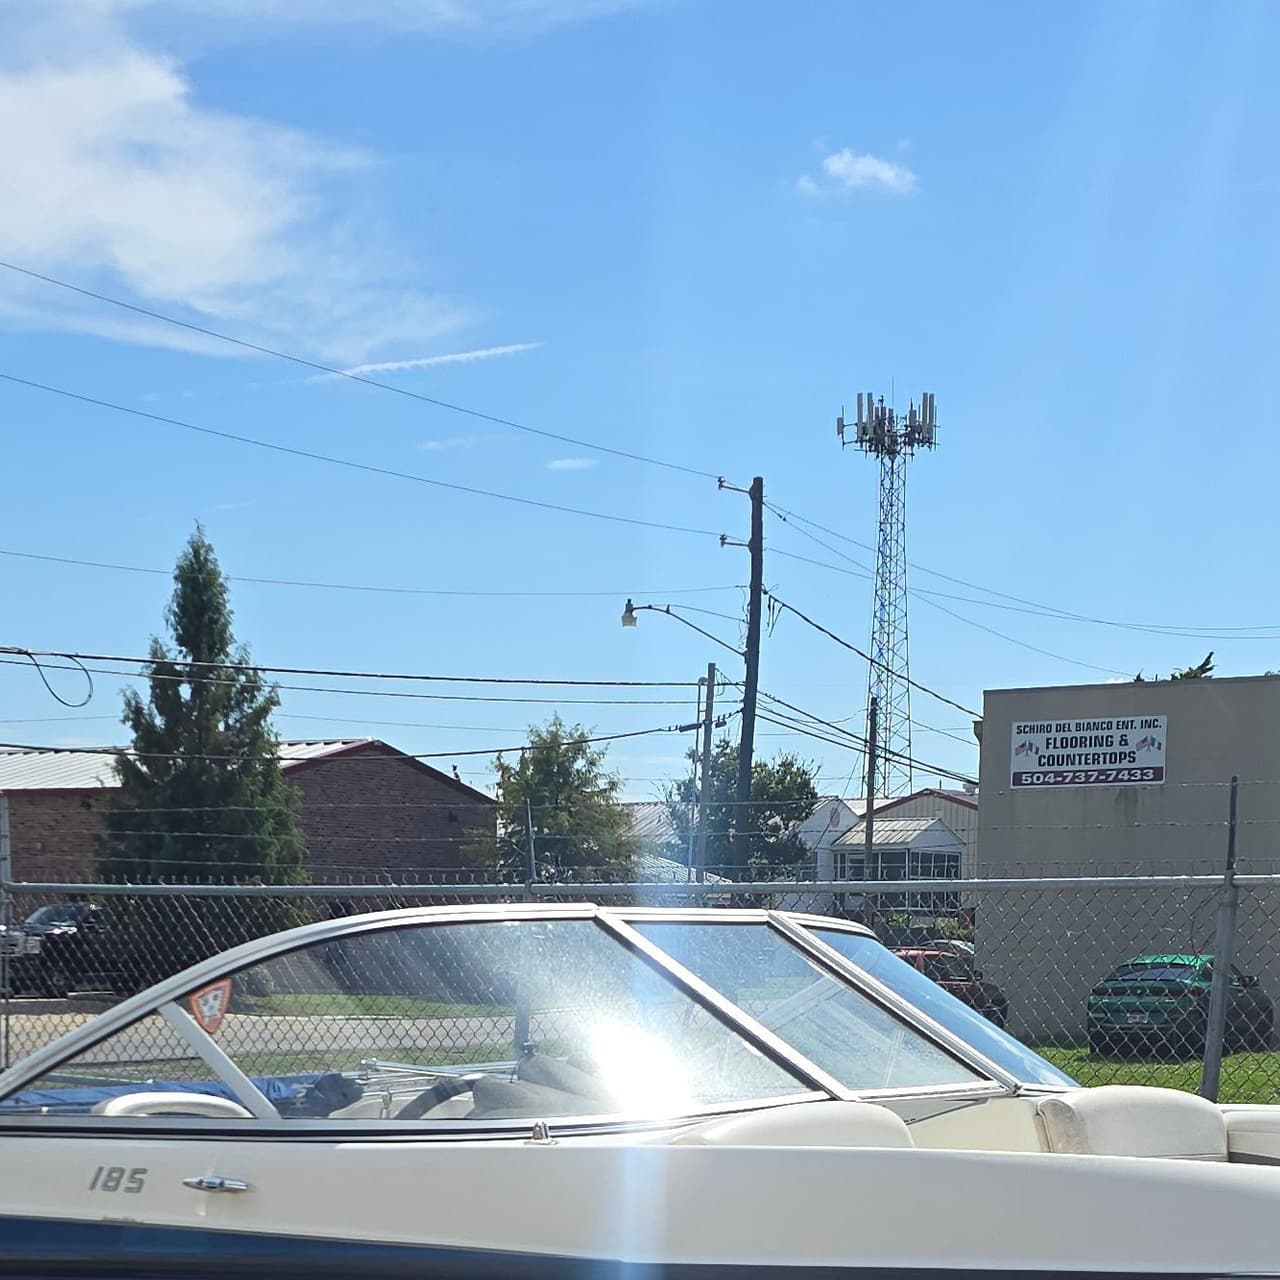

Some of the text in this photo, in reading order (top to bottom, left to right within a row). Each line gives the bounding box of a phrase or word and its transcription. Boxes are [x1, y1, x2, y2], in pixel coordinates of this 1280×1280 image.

[1016, 718, 1162, 734] SCHIRO DEL BIANCO ENT. INC.
[1045, 734, 1129, 750] FLOORING &
[1038, 751, 1137, 767] COUNTERTOPS
[1021, 769, 1155, 784] 504-737-7433
[89, 1166, 148, 1193] 185
